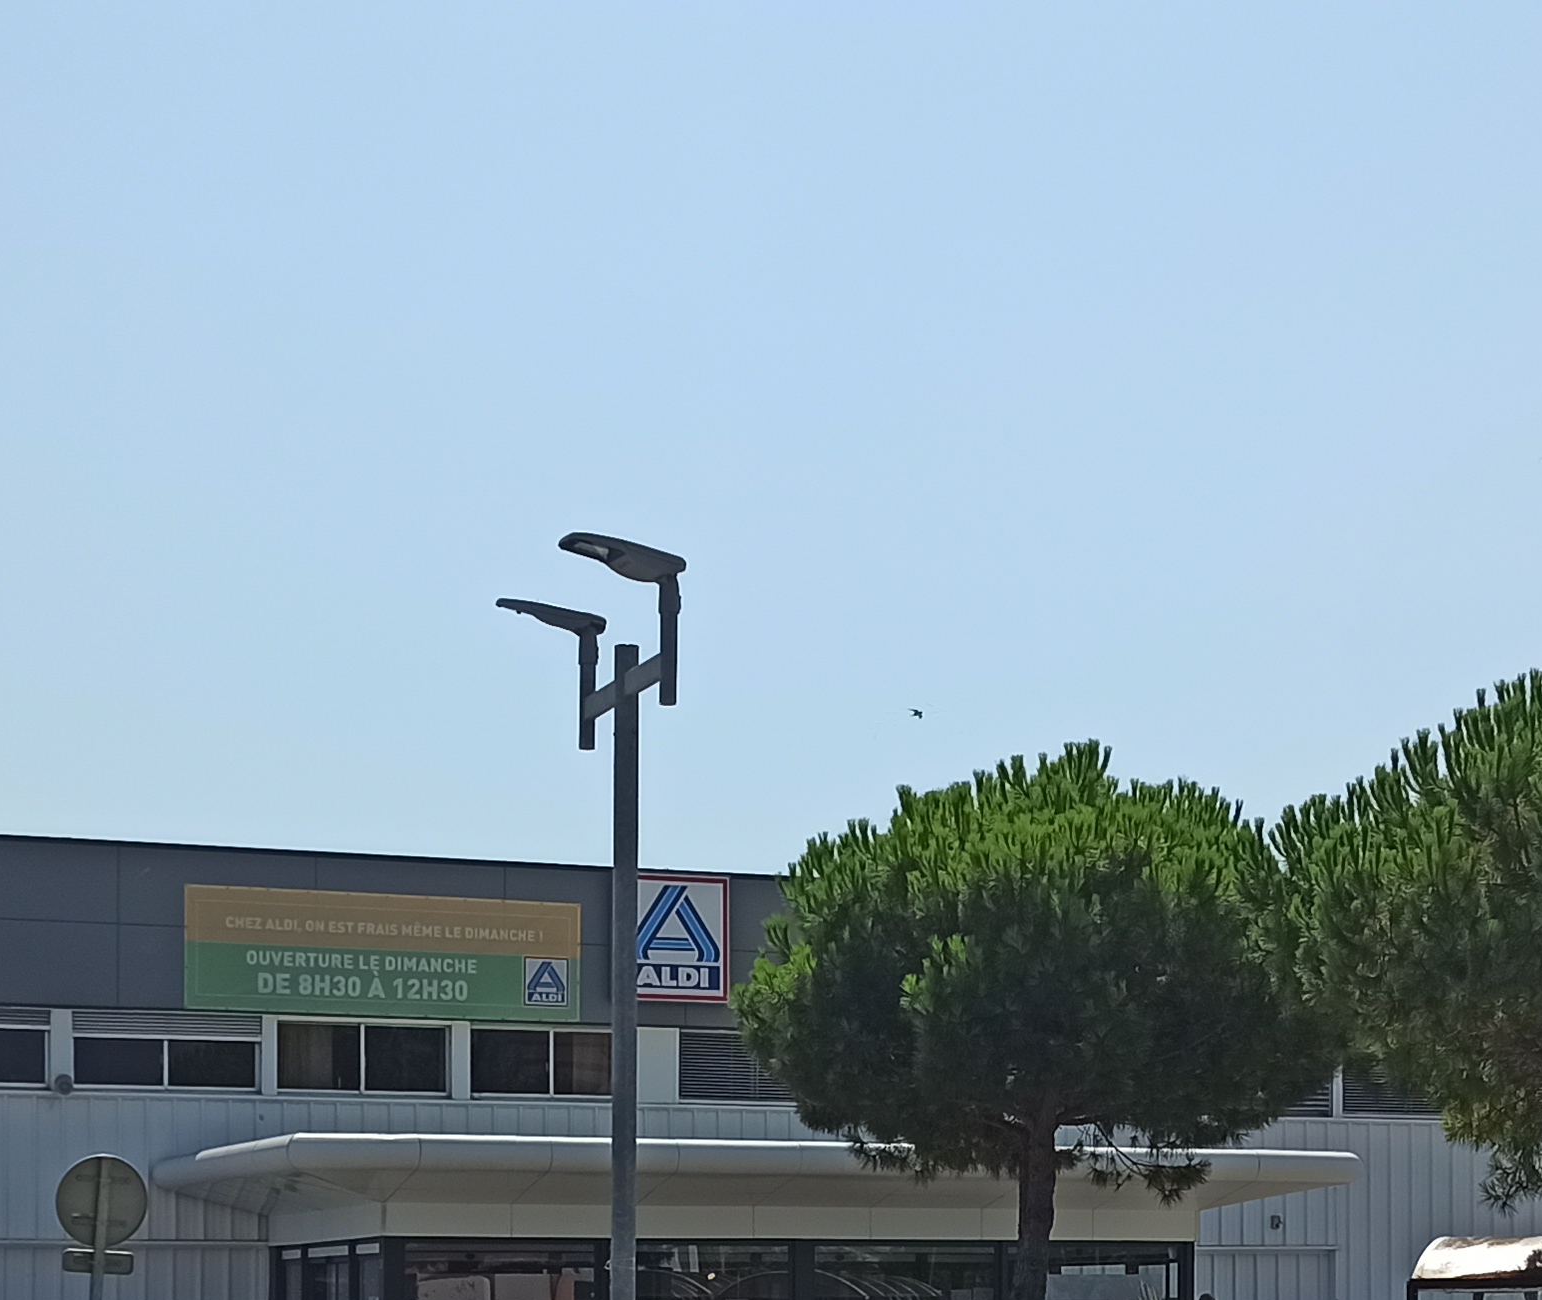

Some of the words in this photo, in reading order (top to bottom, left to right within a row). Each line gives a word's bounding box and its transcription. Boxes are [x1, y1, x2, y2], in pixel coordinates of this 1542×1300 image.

[225, 916, 262, 930] CHEZ
[265, 918, 302, 933] ALDI,
[305, 920, 325, 932] ON
[328, 921, 354, 934] EST
[357, 922, 399, 936] FRAIS
[402, 922, 441, 938] MÊME
[445, 927, 462, 939] LE
[465, 927, 536, 942] DIMANCHE
[246, 950, 355, 969] OUVERTURE
[359, 955, 380, 971] LE
[385, 956, 477, 974] DIMANCHE
[257, 972, 291, 995] DE
[298, 974, 362, 998] 8H30
[367, 971, 386, 998] À
[393, 978, 469, 1001] 12H30
[637, 965, 709, 988] ALDI
[531, 993, 563, 1002] ALDI
